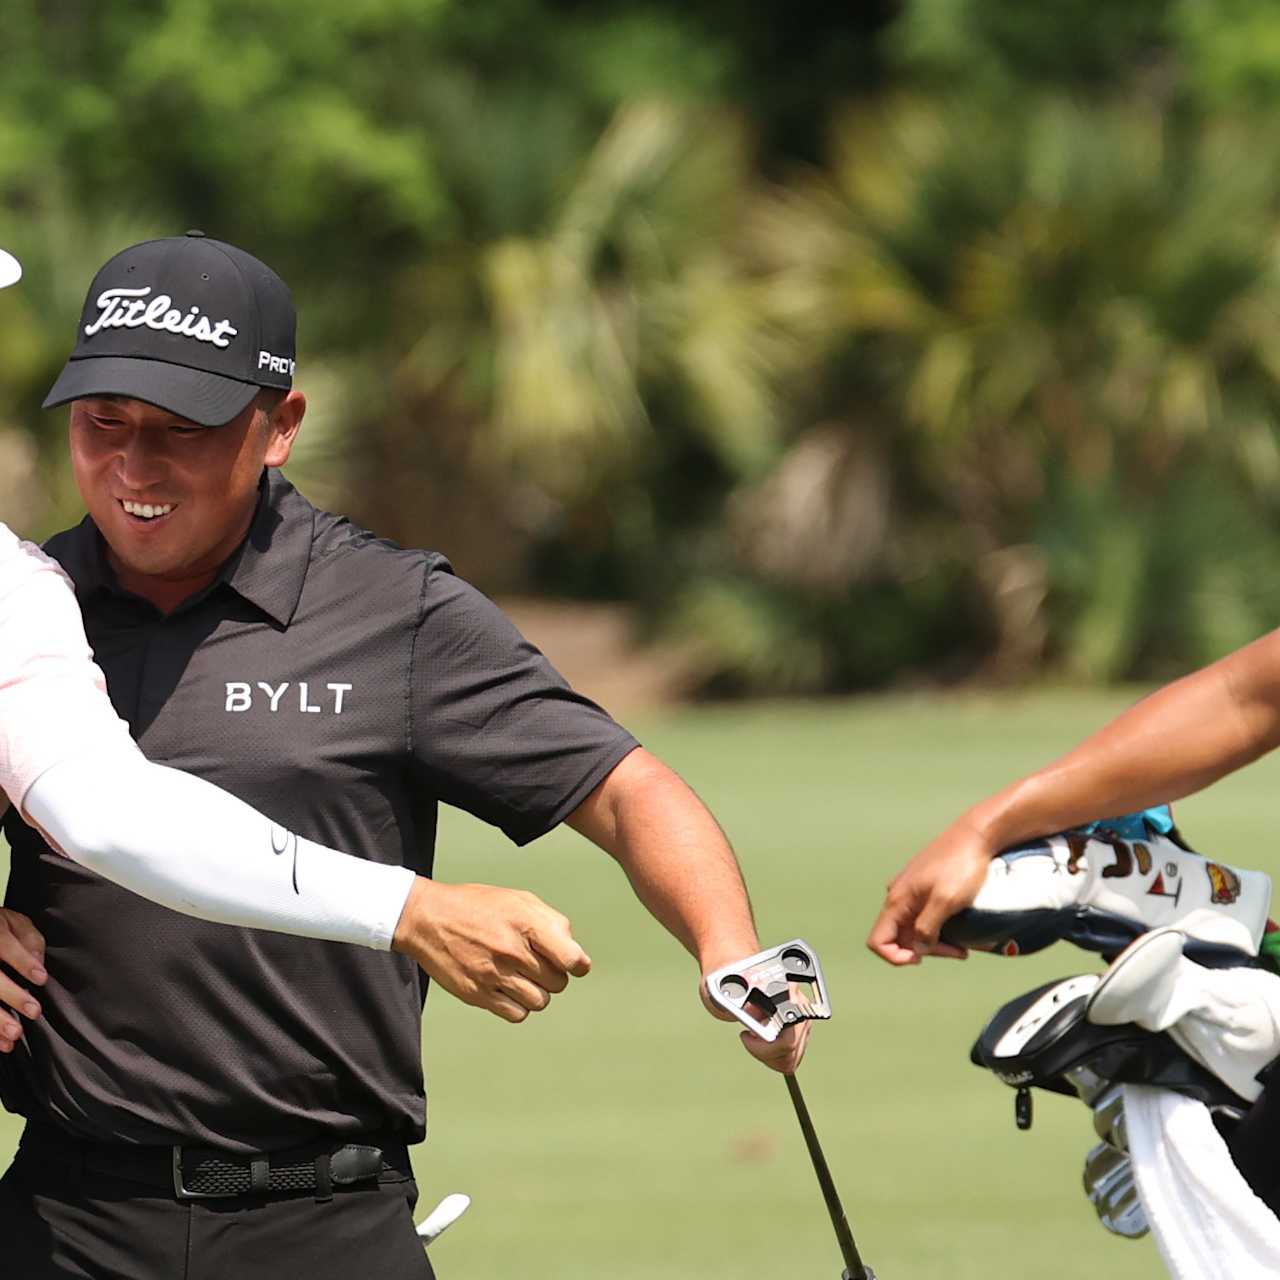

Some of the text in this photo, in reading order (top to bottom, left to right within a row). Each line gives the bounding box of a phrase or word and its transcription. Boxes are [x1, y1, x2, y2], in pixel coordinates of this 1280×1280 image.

[83, 285, 238, 348] Titleist
[257, 351, 289, 374] PRO
[223, 680, 354, 714] BYLT
